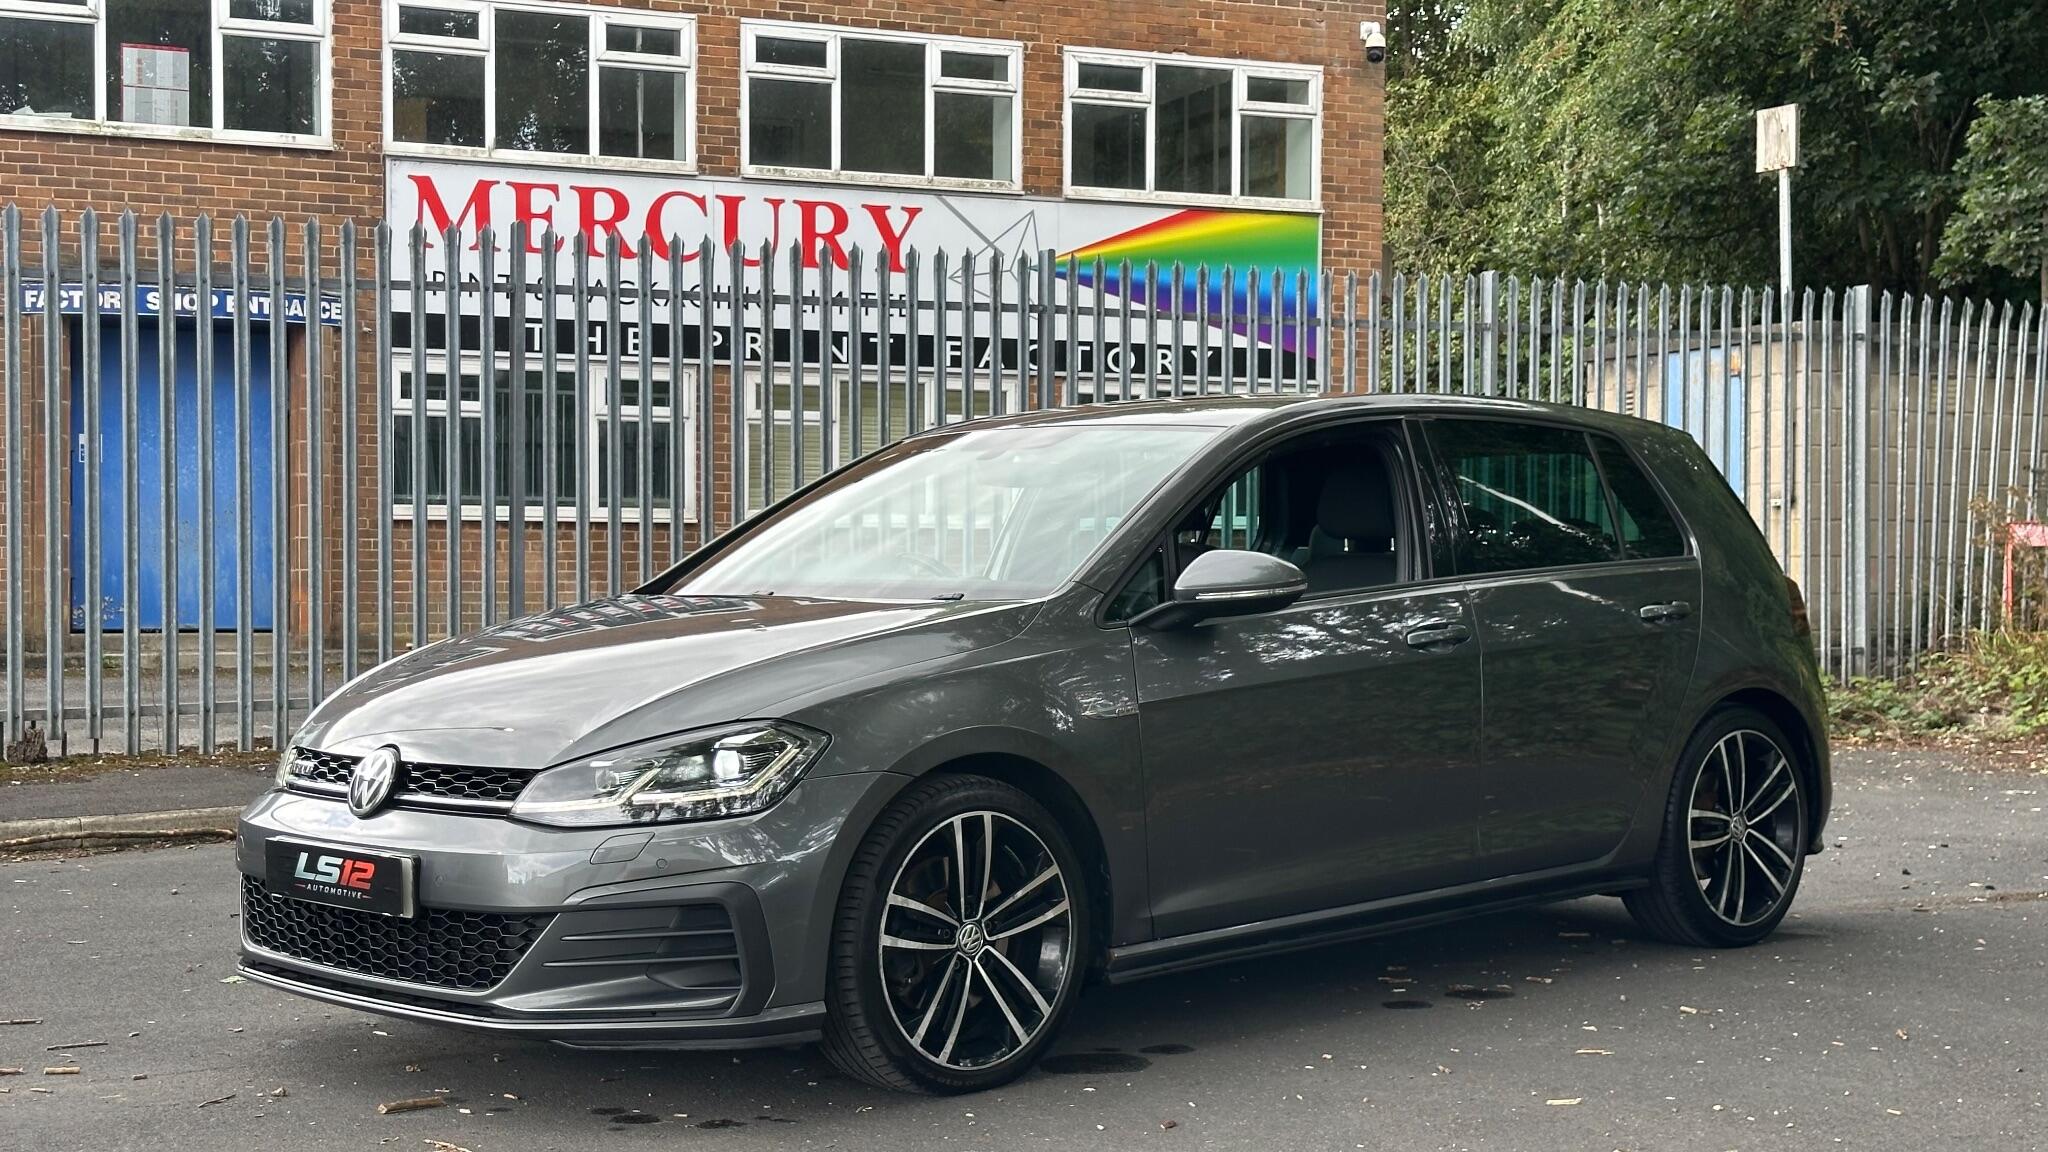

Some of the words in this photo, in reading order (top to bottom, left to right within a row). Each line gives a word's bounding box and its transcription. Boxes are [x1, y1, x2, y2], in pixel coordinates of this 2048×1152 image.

[407, 174, 923, 273] MERCURY
[226, 294, 342, 320] ENTACE
[524, 322, 641, 355] THE
[294, 851, 376, 891] LS12
[306, 883, 363, 899] AUTOMOTIVE
